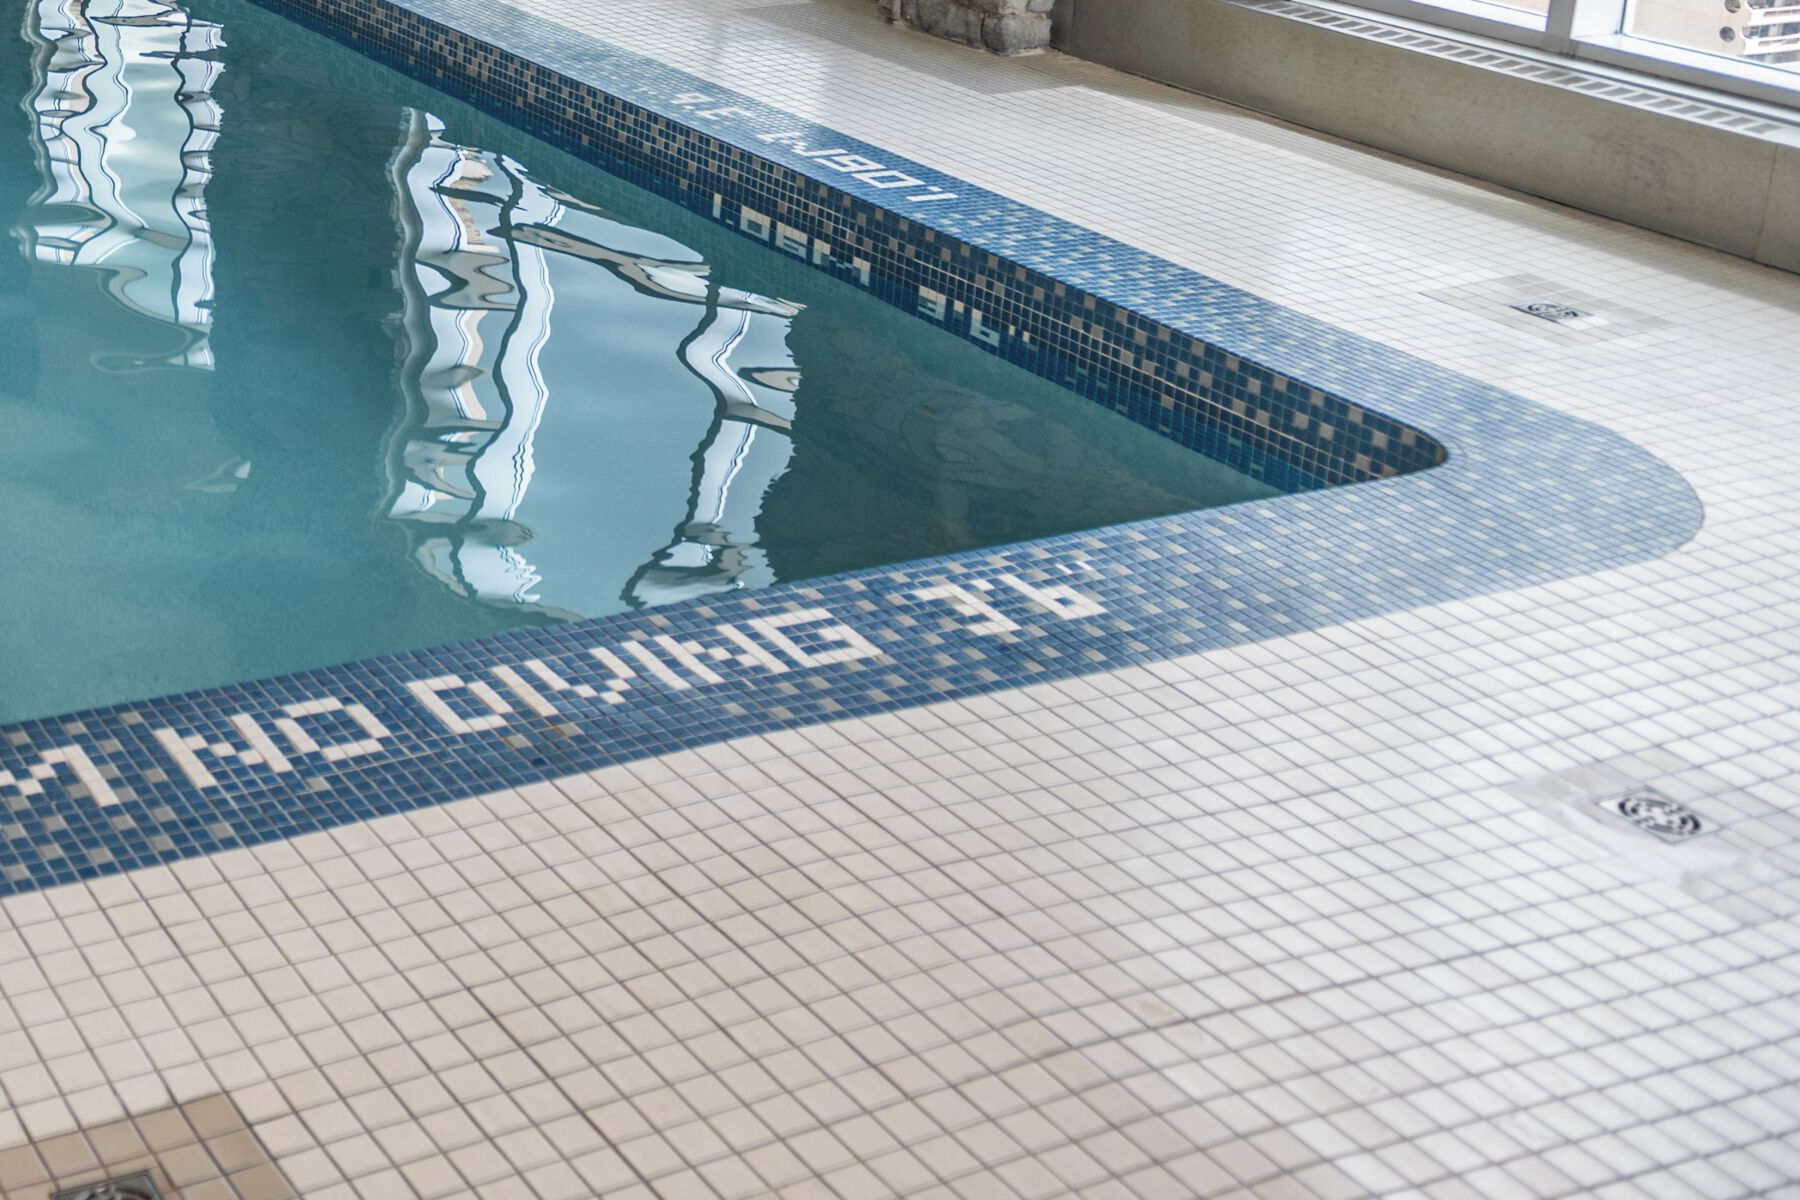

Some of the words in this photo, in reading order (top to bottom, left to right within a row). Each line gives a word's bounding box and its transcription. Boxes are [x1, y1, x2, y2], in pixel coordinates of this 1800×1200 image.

[712, 191, 871, 287] 1.06M
[153, 697, 391, 789] NO
[406, 607, 885, 735] DIVING
